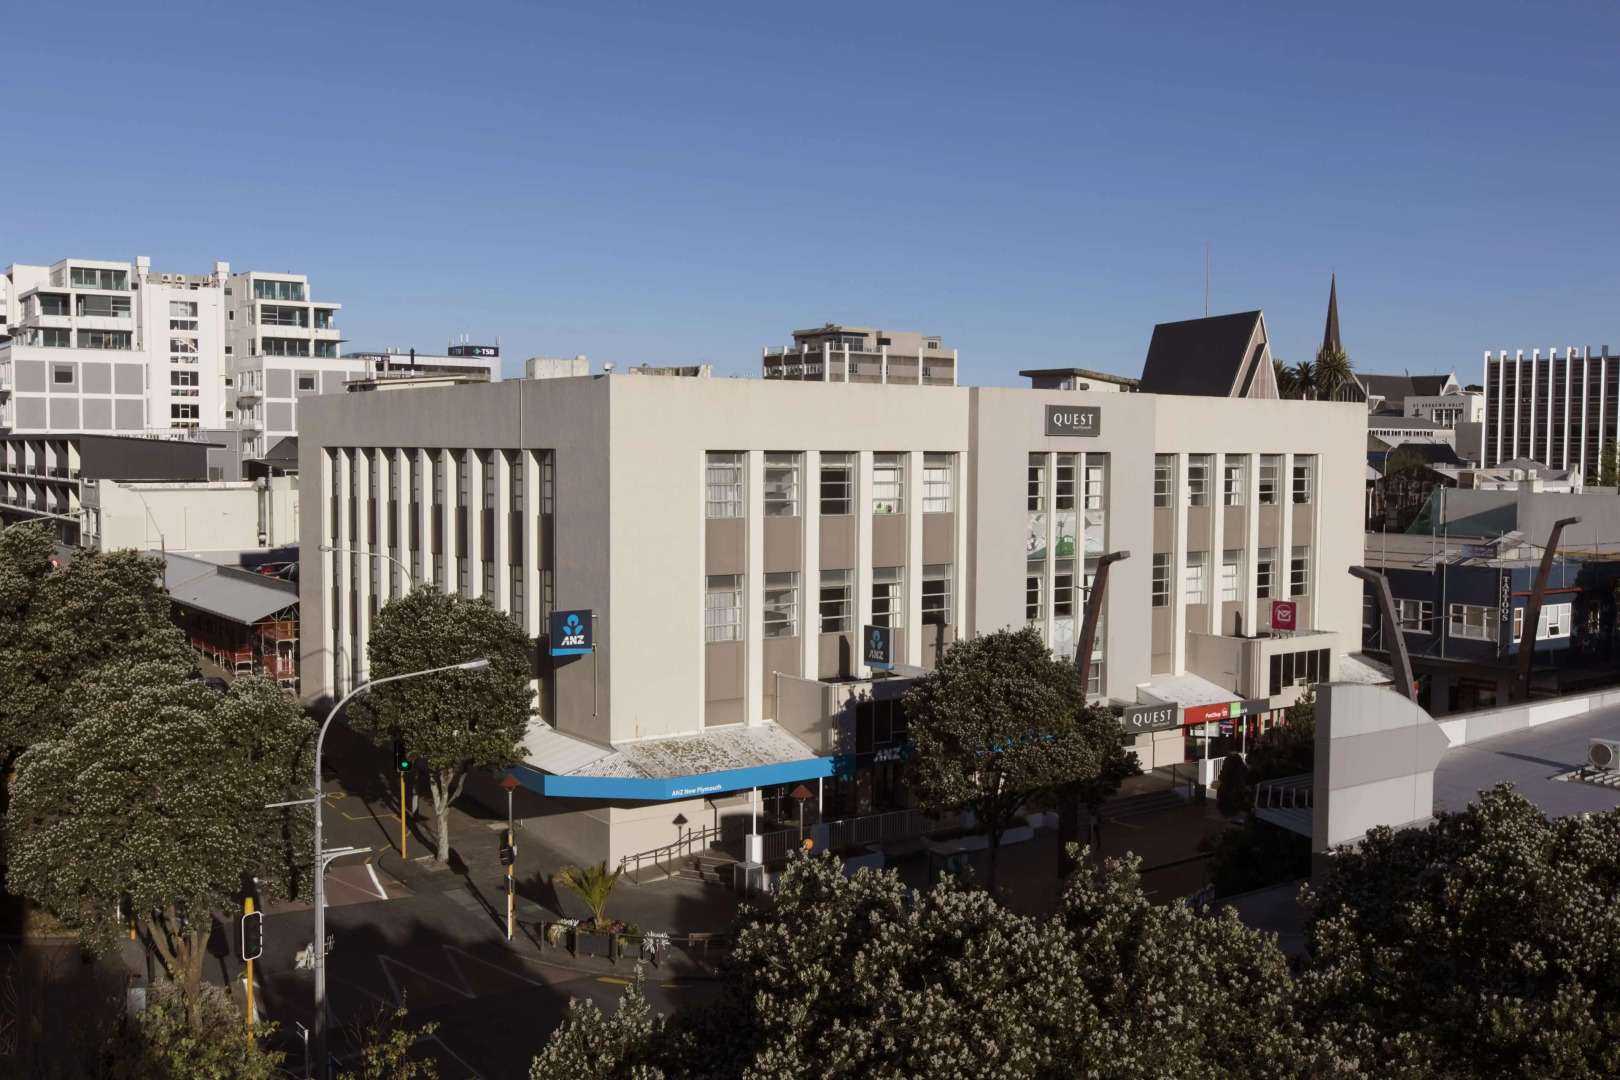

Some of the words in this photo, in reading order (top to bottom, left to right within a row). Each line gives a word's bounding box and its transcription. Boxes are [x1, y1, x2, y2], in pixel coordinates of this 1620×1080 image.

[1053, 413, 1094, 427] QUEST
[1501, 576, 1510, 622] TATTOOS
[560, 634, 585, 646] ANZ
[868, 649, 884, 660] ANZ
[1133, 709, 1172, 726] QUEST
[873, 745, 902, 763] ANZ
[671, 789, 683, 797] ANZ
[697, 783, 722, 794] Plymouth
